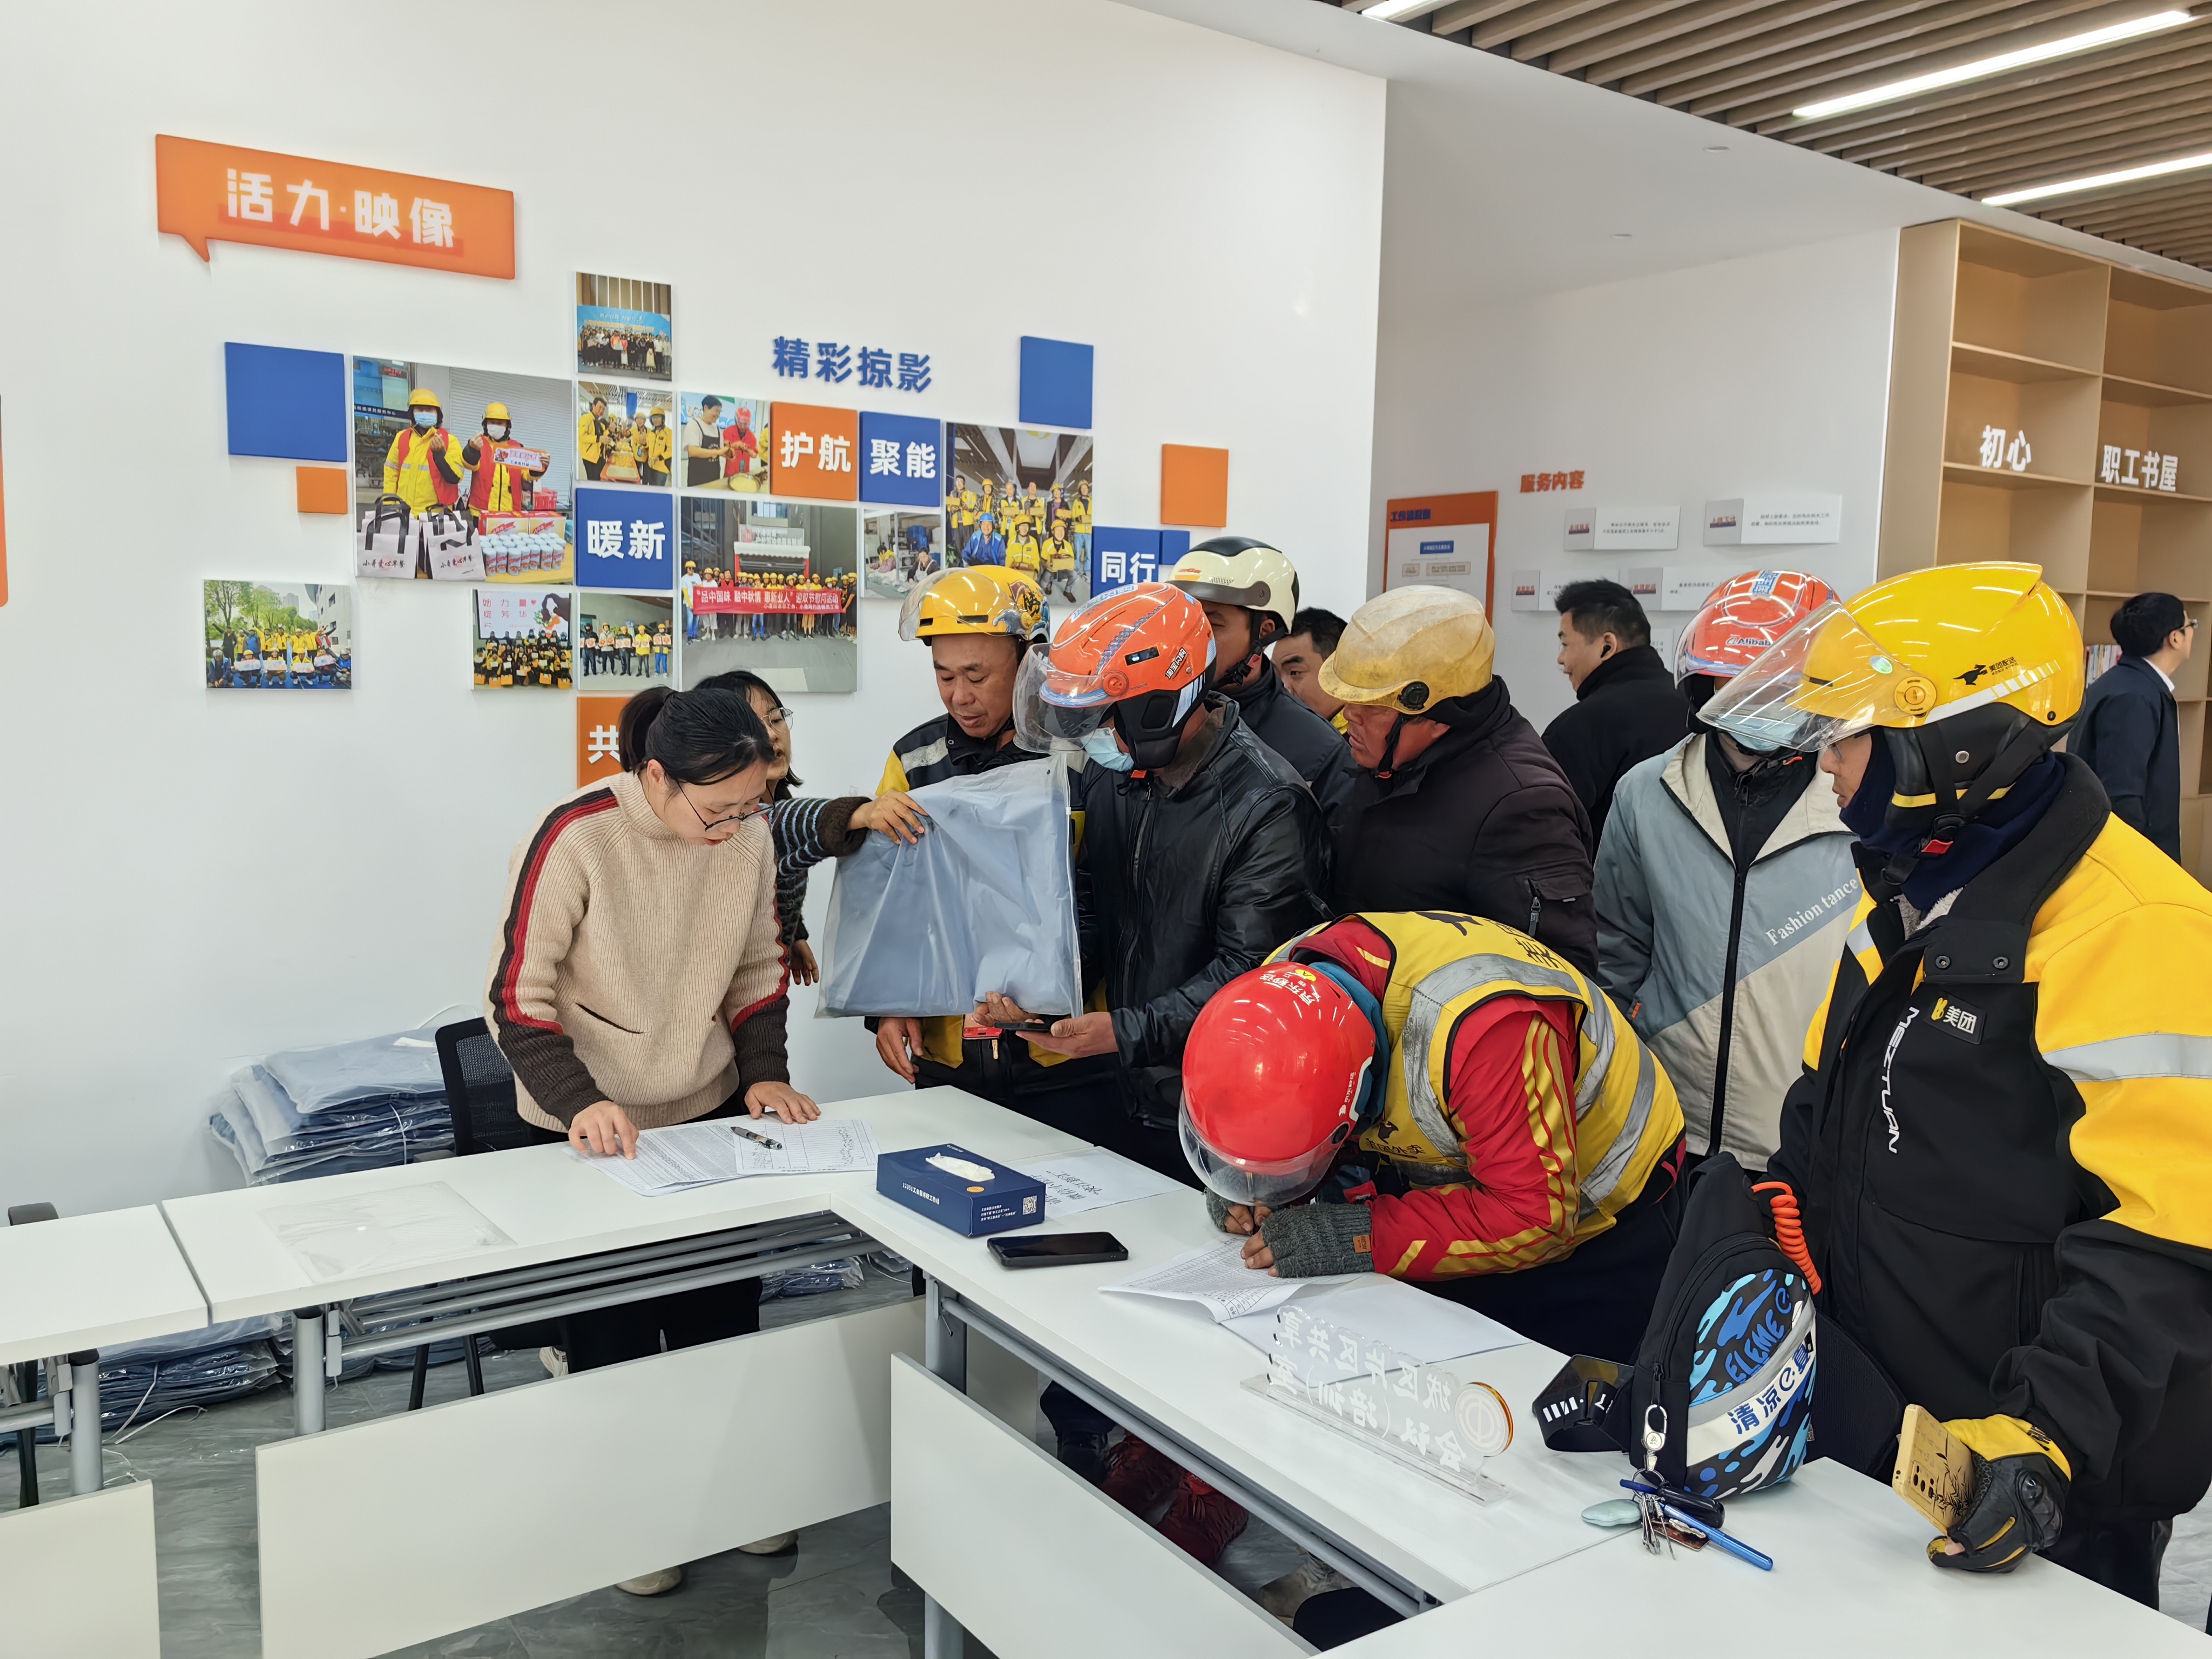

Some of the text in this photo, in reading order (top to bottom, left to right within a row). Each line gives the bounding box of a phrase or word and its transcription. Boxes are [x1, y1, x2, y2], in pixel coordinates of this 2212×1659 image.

[227, 168, 454, 248] 活力·映像
[772, 335, 933, 394] 精彩掠影
[780, 430, 852, 473] 护航
[869, 439, 936, 478] 聚能
[1979, 424, 2032, 471] 初心
[2101, 444, 2179, 492] 职工书屋
[1520, 470, 1585, 493] 服务内容
[588, 520, 666, 560] 暖新
[1101, 551, 1157, 584] 同行
[1165, 648, 1187, 679] 淘宝闪购
[1765, 877, 1859, 946] Fashion tance
[1259, 973, 1316, 1006] 京东秒送
[1944, 1006, 1977, 1035] 美团
[1725, 1309, 1784, 1384] ELEME
